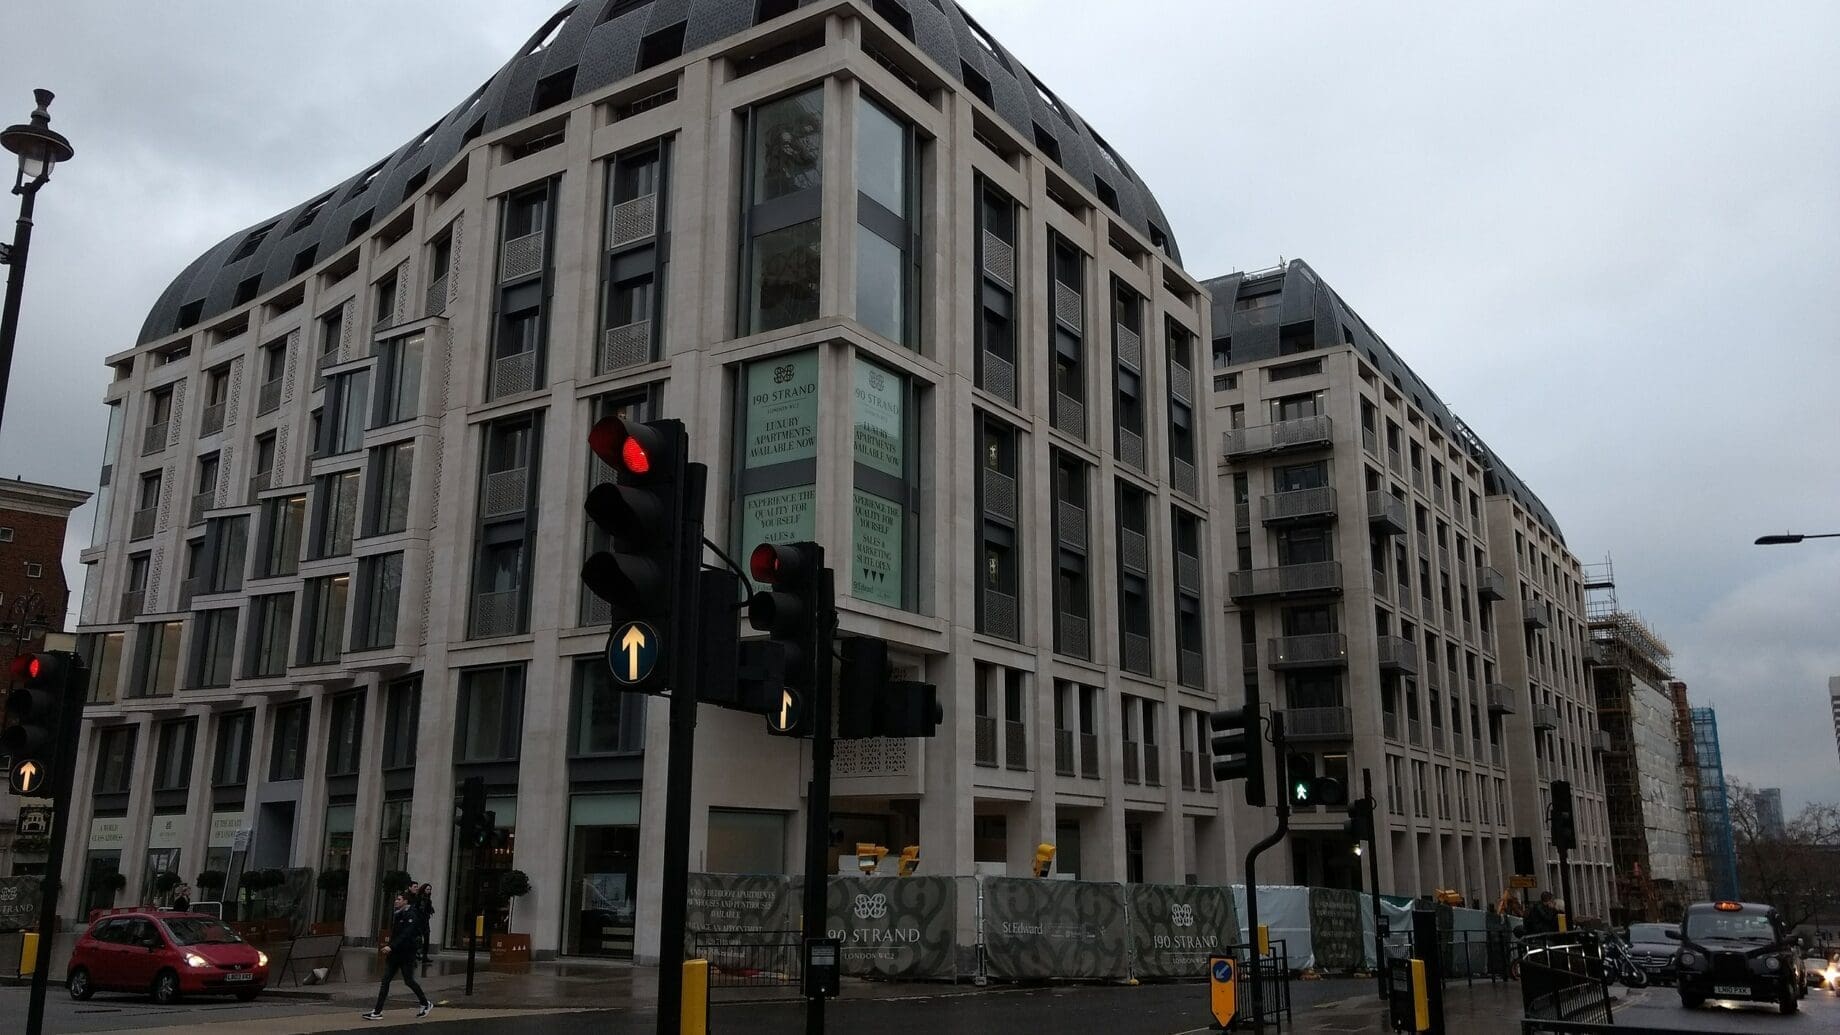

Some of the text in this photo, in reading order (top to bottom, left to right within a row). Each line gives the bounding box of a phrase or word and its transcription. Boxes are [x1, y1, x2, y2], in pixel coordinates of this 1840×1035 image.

[753, 383, 816, 406] 190 STRAND
[855, 388, 899, 415] 90 STRAND
[766, 416, 800, 431] LUXURY
[755, 426, 811, 445] APARTMENTS
[856, 431, 896, 453] APARTMENTS
[750, 436, 816, 457] AVAILABLE NOW
[854, 441, 884, 461] VAILABLE
[748, 490, 816, 509] EXPERIENCE THE
[853, 494, 899, 516] XPERIENCE THE
[755, 503, 807, 520] QUALITY FOR
[855, 506, 893, 526] QUALITY FOR
[760, 514, 800, 528] YOURSELF
[860, 518, 889, 535] YOURSELF
[765, 531, 788, 542] SALES
[862, 535, 881, 547] SALES
[856, 542, 892, 561] MARKETING
[857, 553, 891, 572] SUITE OPEN
[0, 904, 34, 913] TRAND
[827, 928, 920, 943] 90 STRAND
[1012, 922, 1043, 935] Edward
[1154, 935, 1218, 948] 190 STRAND
[844, 952, 876, 960] LONDON
